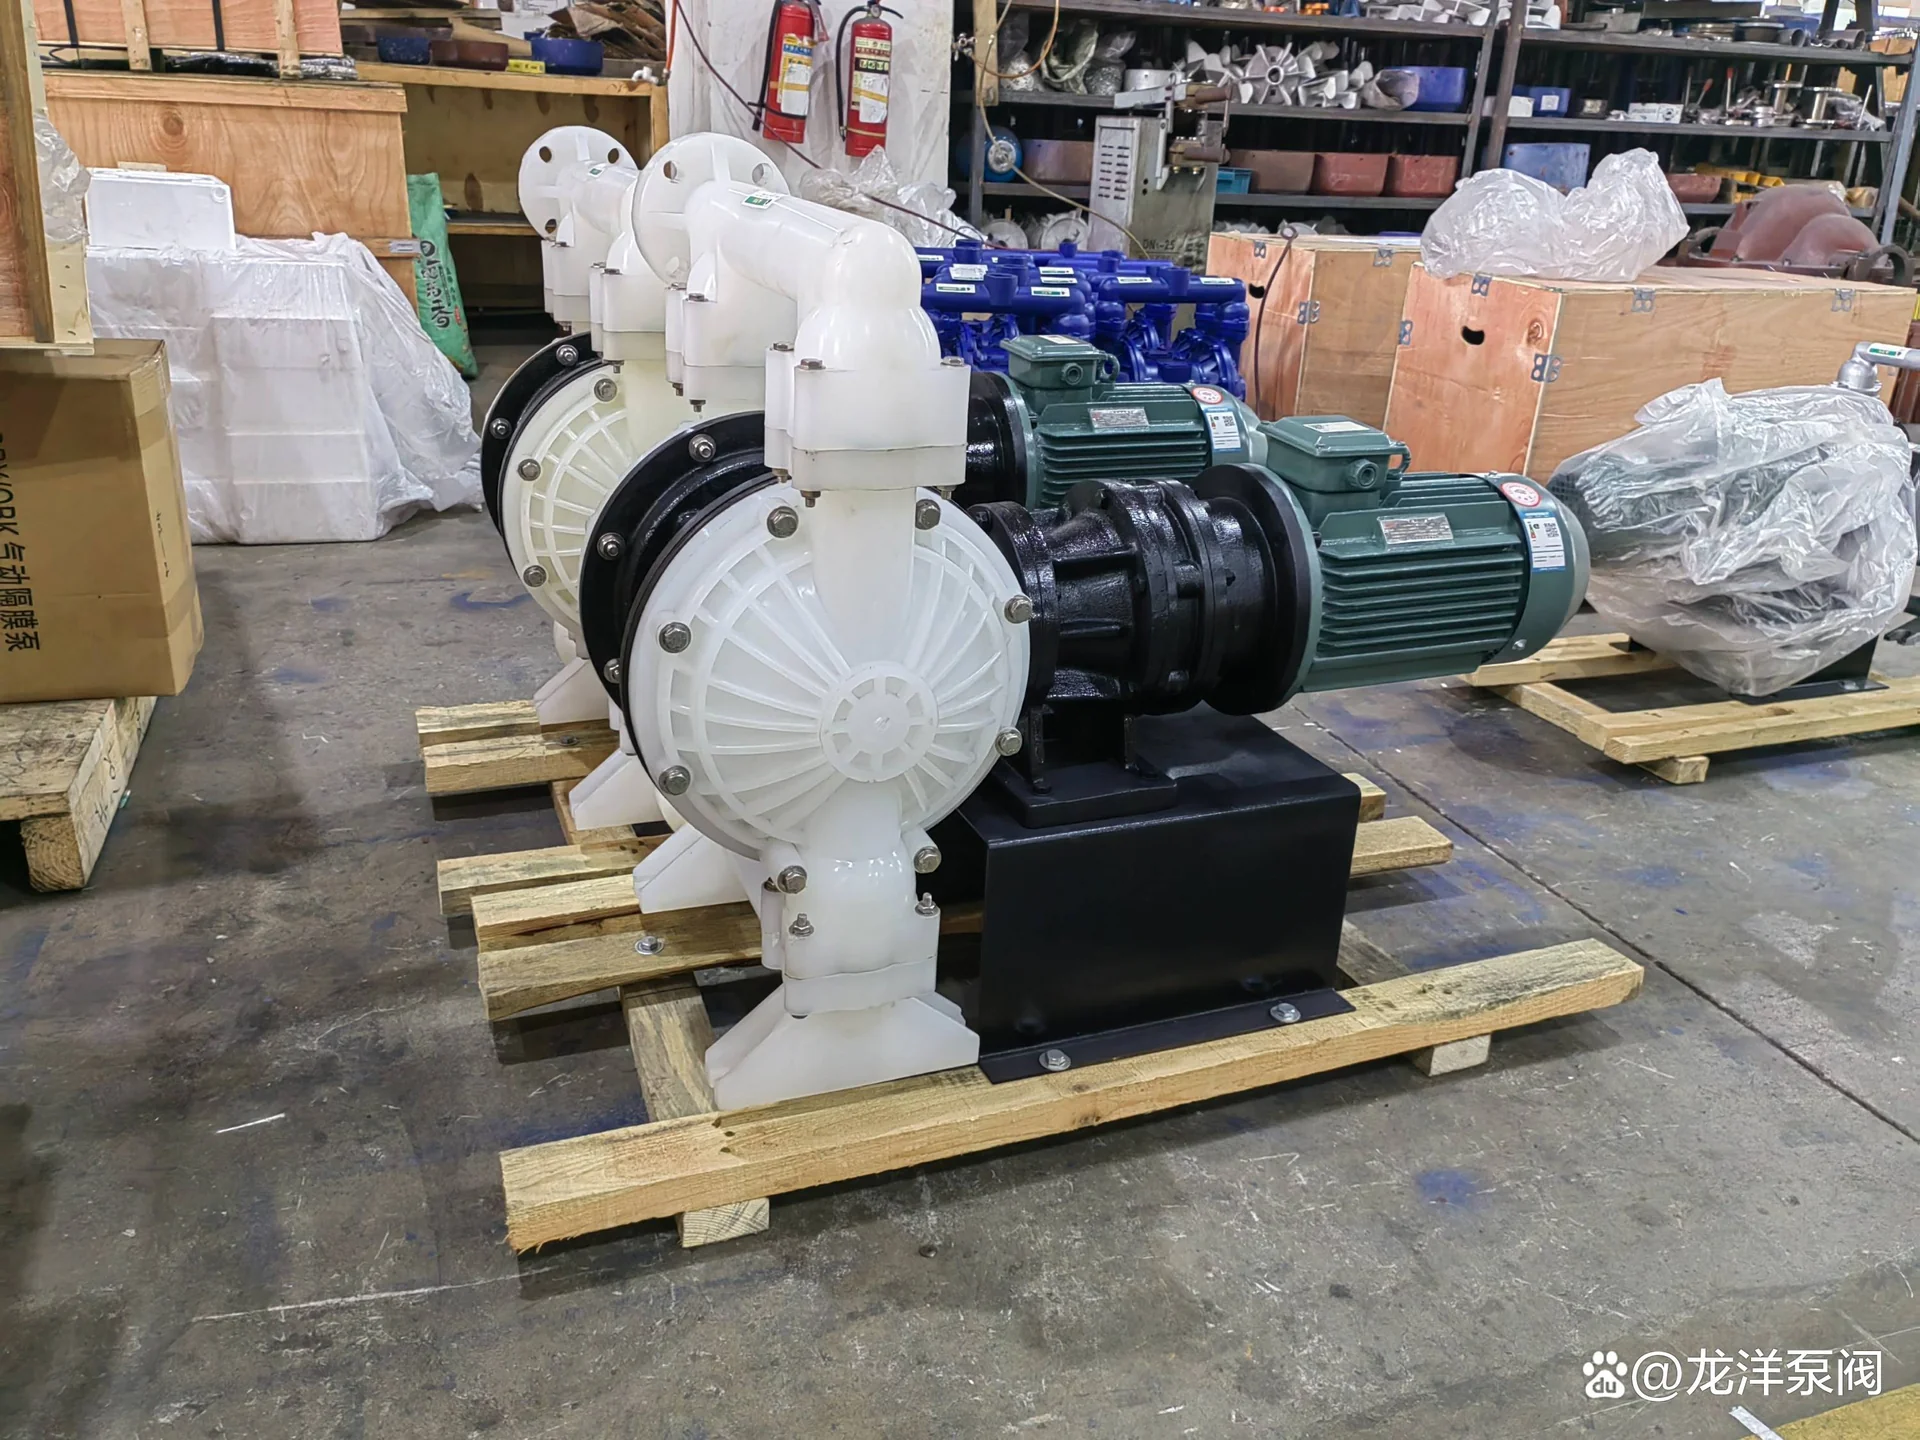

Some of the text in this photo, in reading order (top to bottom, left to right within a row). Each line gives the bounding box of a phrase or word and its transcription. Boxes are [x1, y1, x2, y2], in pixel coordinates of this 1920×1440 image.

[0, 541, 40, 651] 气动隔膜泵
